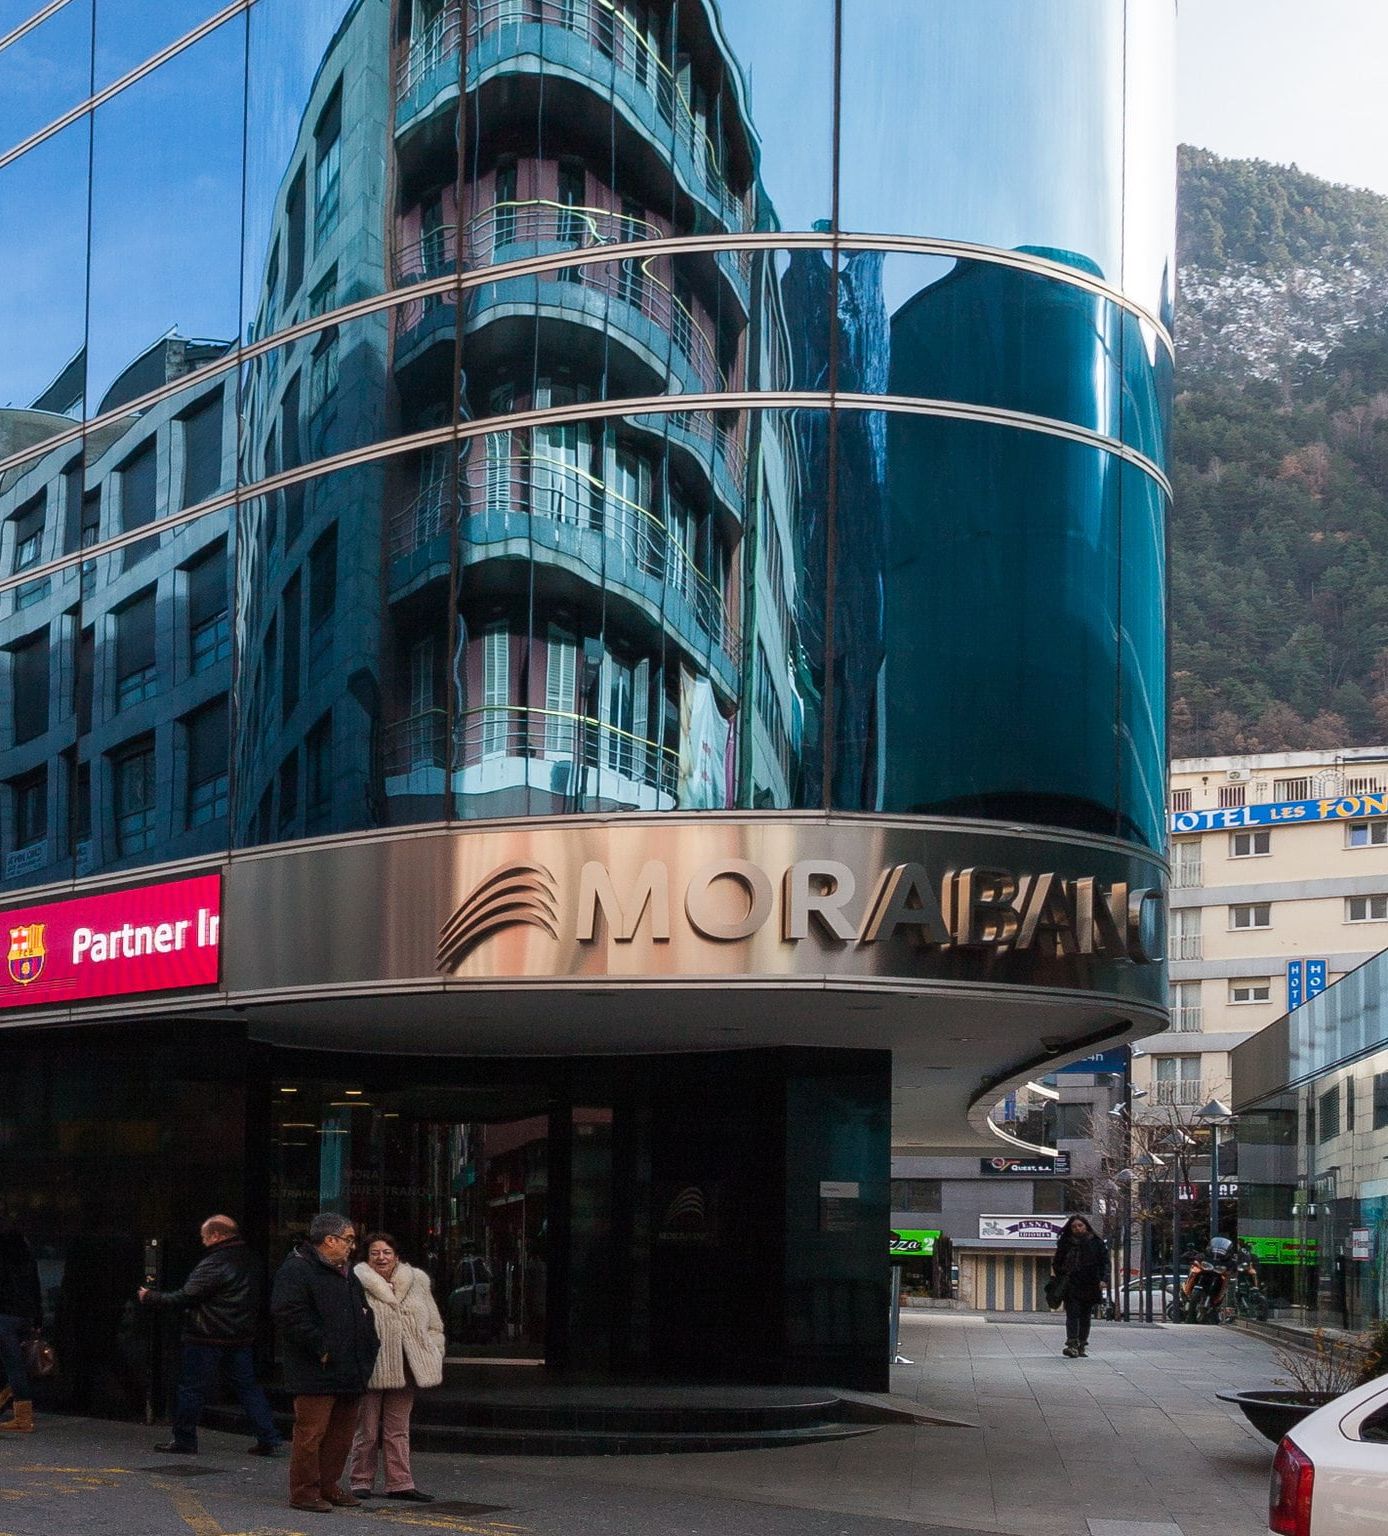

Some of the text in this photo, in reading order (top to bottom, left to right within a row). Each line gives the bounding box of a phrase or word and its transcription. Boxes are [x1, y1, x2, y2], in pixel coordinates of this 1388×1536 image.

[1270, 805, 1306, 820] LES
[1317, 795, 1388, 818] FON
[575, 860, 1164, 964] MORABANC
[73, 921, 189, 964] Partner
